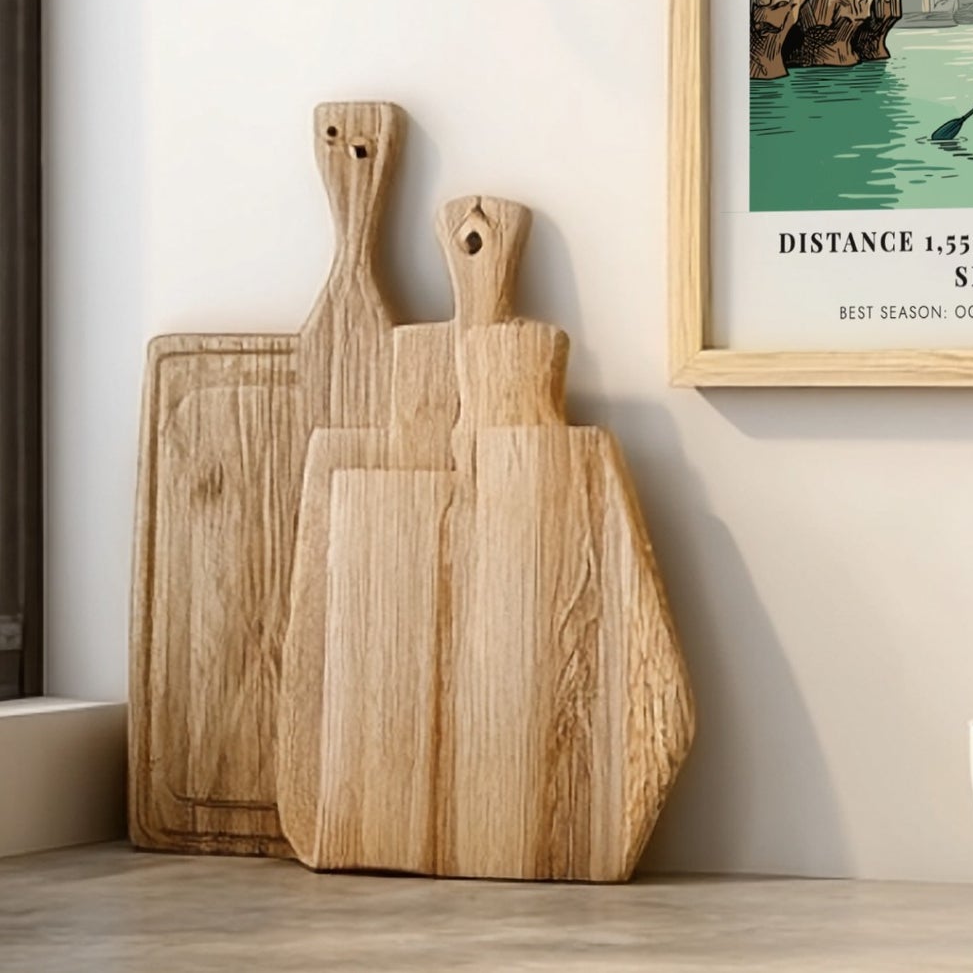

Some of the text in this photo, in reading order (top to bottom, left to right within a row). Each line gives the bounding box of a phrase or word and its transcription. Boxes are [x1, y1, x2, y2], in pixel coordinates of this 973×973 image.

[779, 231, 913, 254] DISTANCE
[839, 305, 873, 320] BEST
[879, 304, 948, 320] SEASON:
